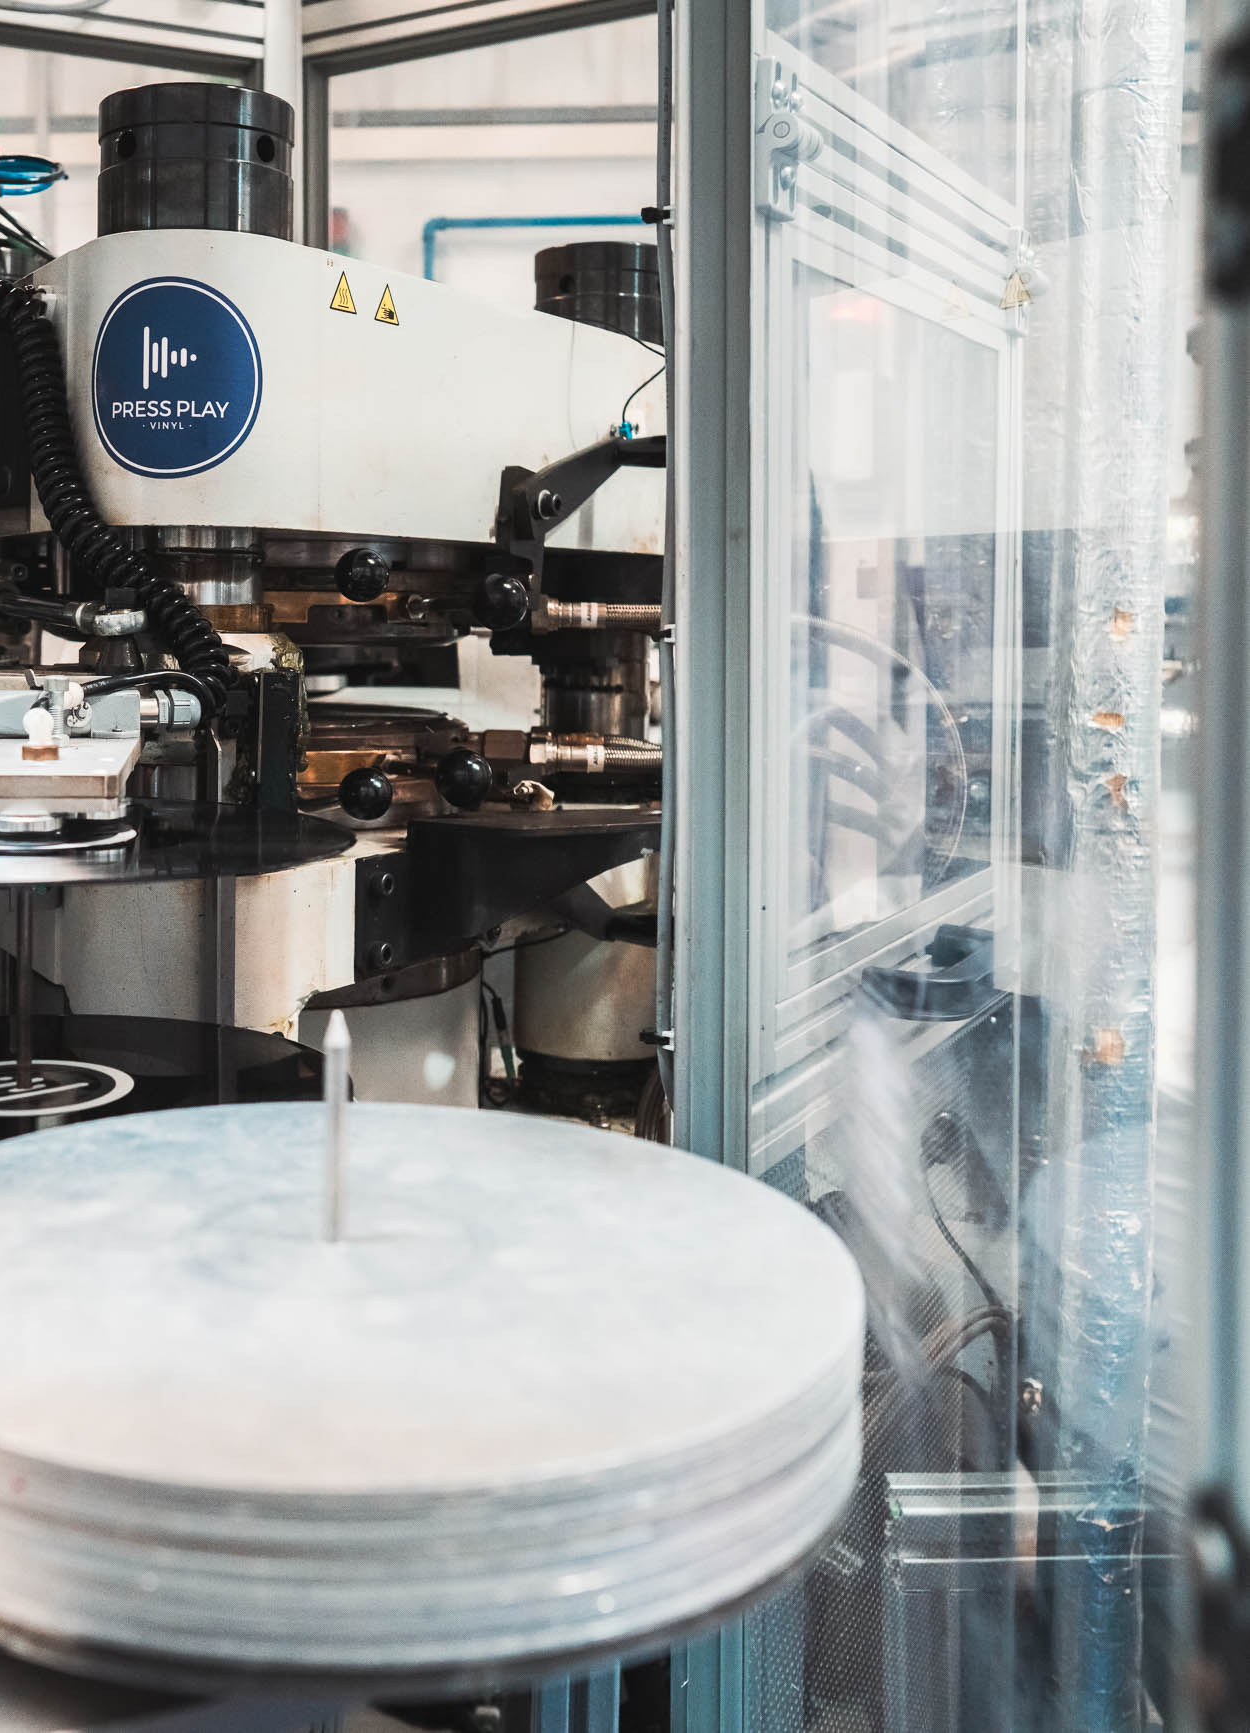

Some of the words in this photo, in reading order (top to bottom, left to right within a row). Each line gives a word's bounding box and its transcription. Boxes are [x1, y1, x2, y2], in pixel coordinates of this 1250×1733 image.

[112, 399, 172, 419] PRESS
[176, 400, 230, 419] PLAY
[149, 421, 185, 430] VINYL
